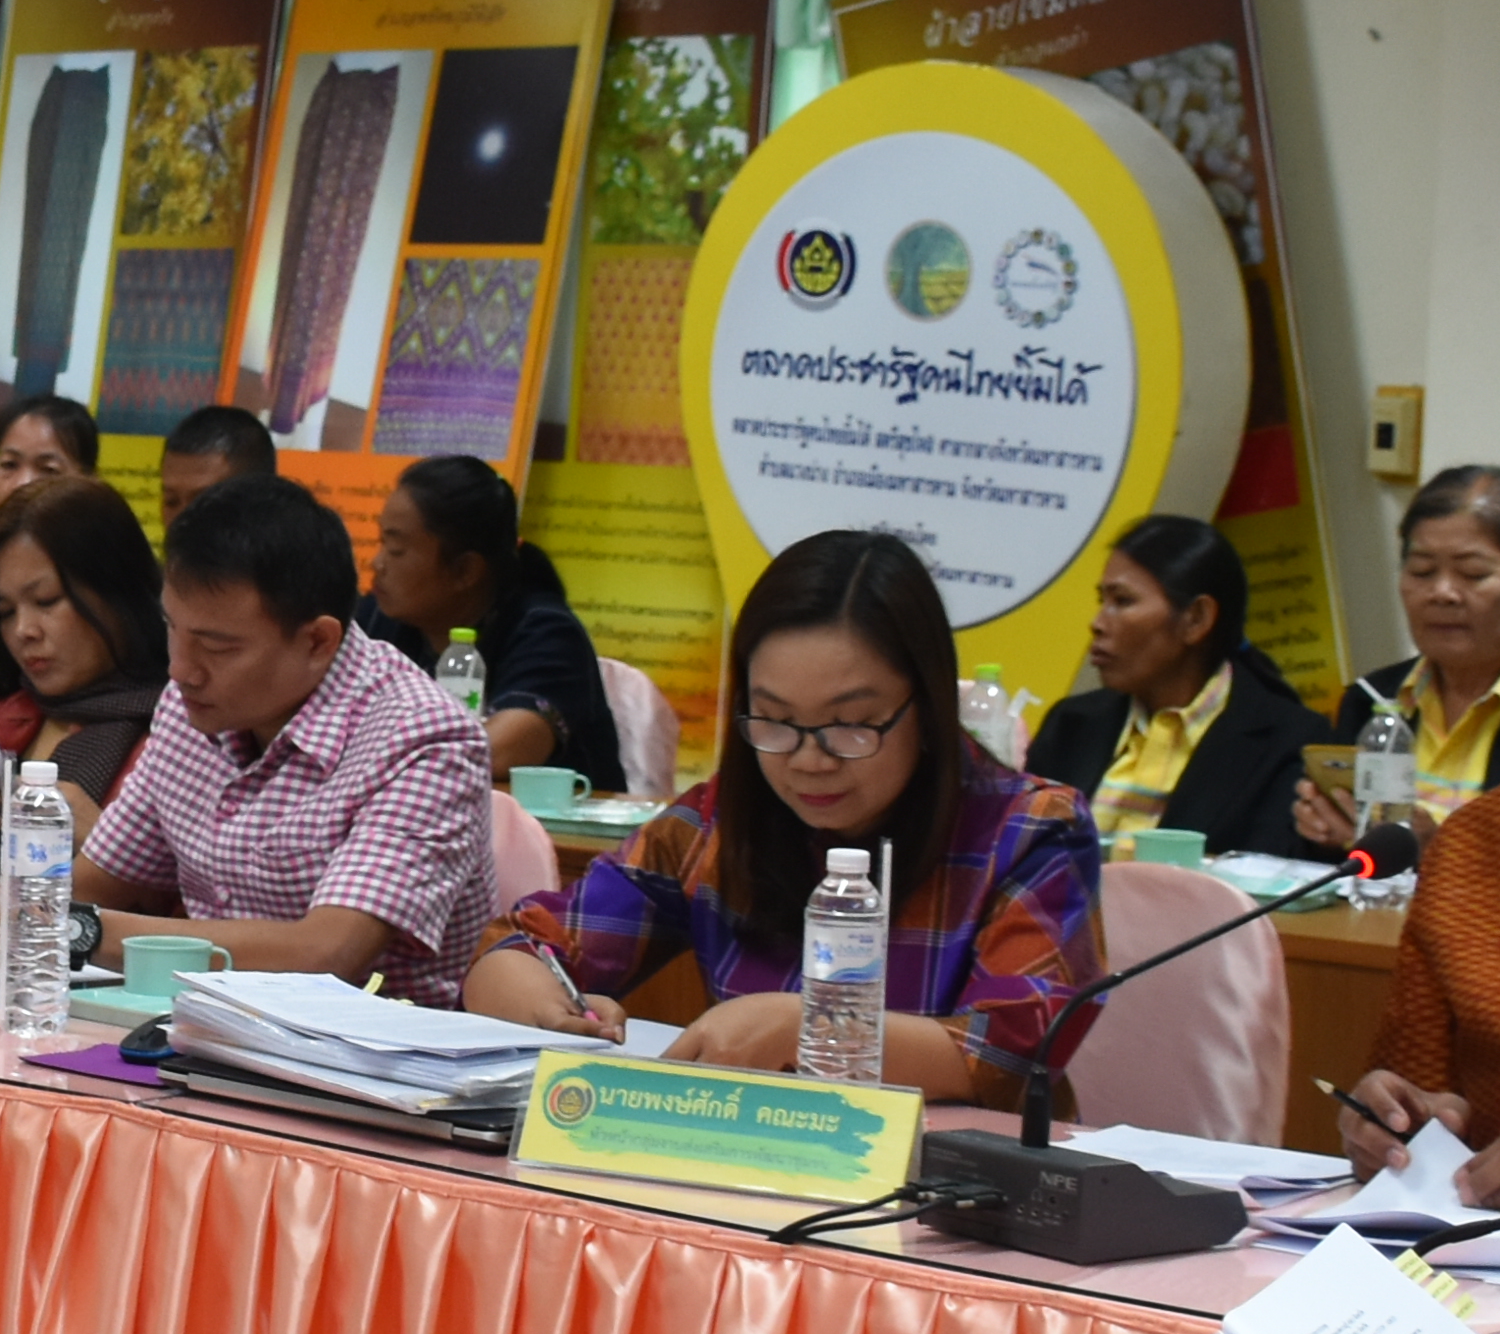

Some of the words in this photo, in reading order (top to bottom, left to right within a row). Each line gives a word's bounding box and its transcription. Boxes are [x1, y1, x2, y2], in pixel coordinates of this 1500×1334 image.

[741, 346, 1103, 405] ตลาดประชารัฐคนไทยยิ้มได้
[599, 1084, 744, 1121] นายพงษ์ศักดิ์
[1039, 1170, 1079, 1193] NPE
